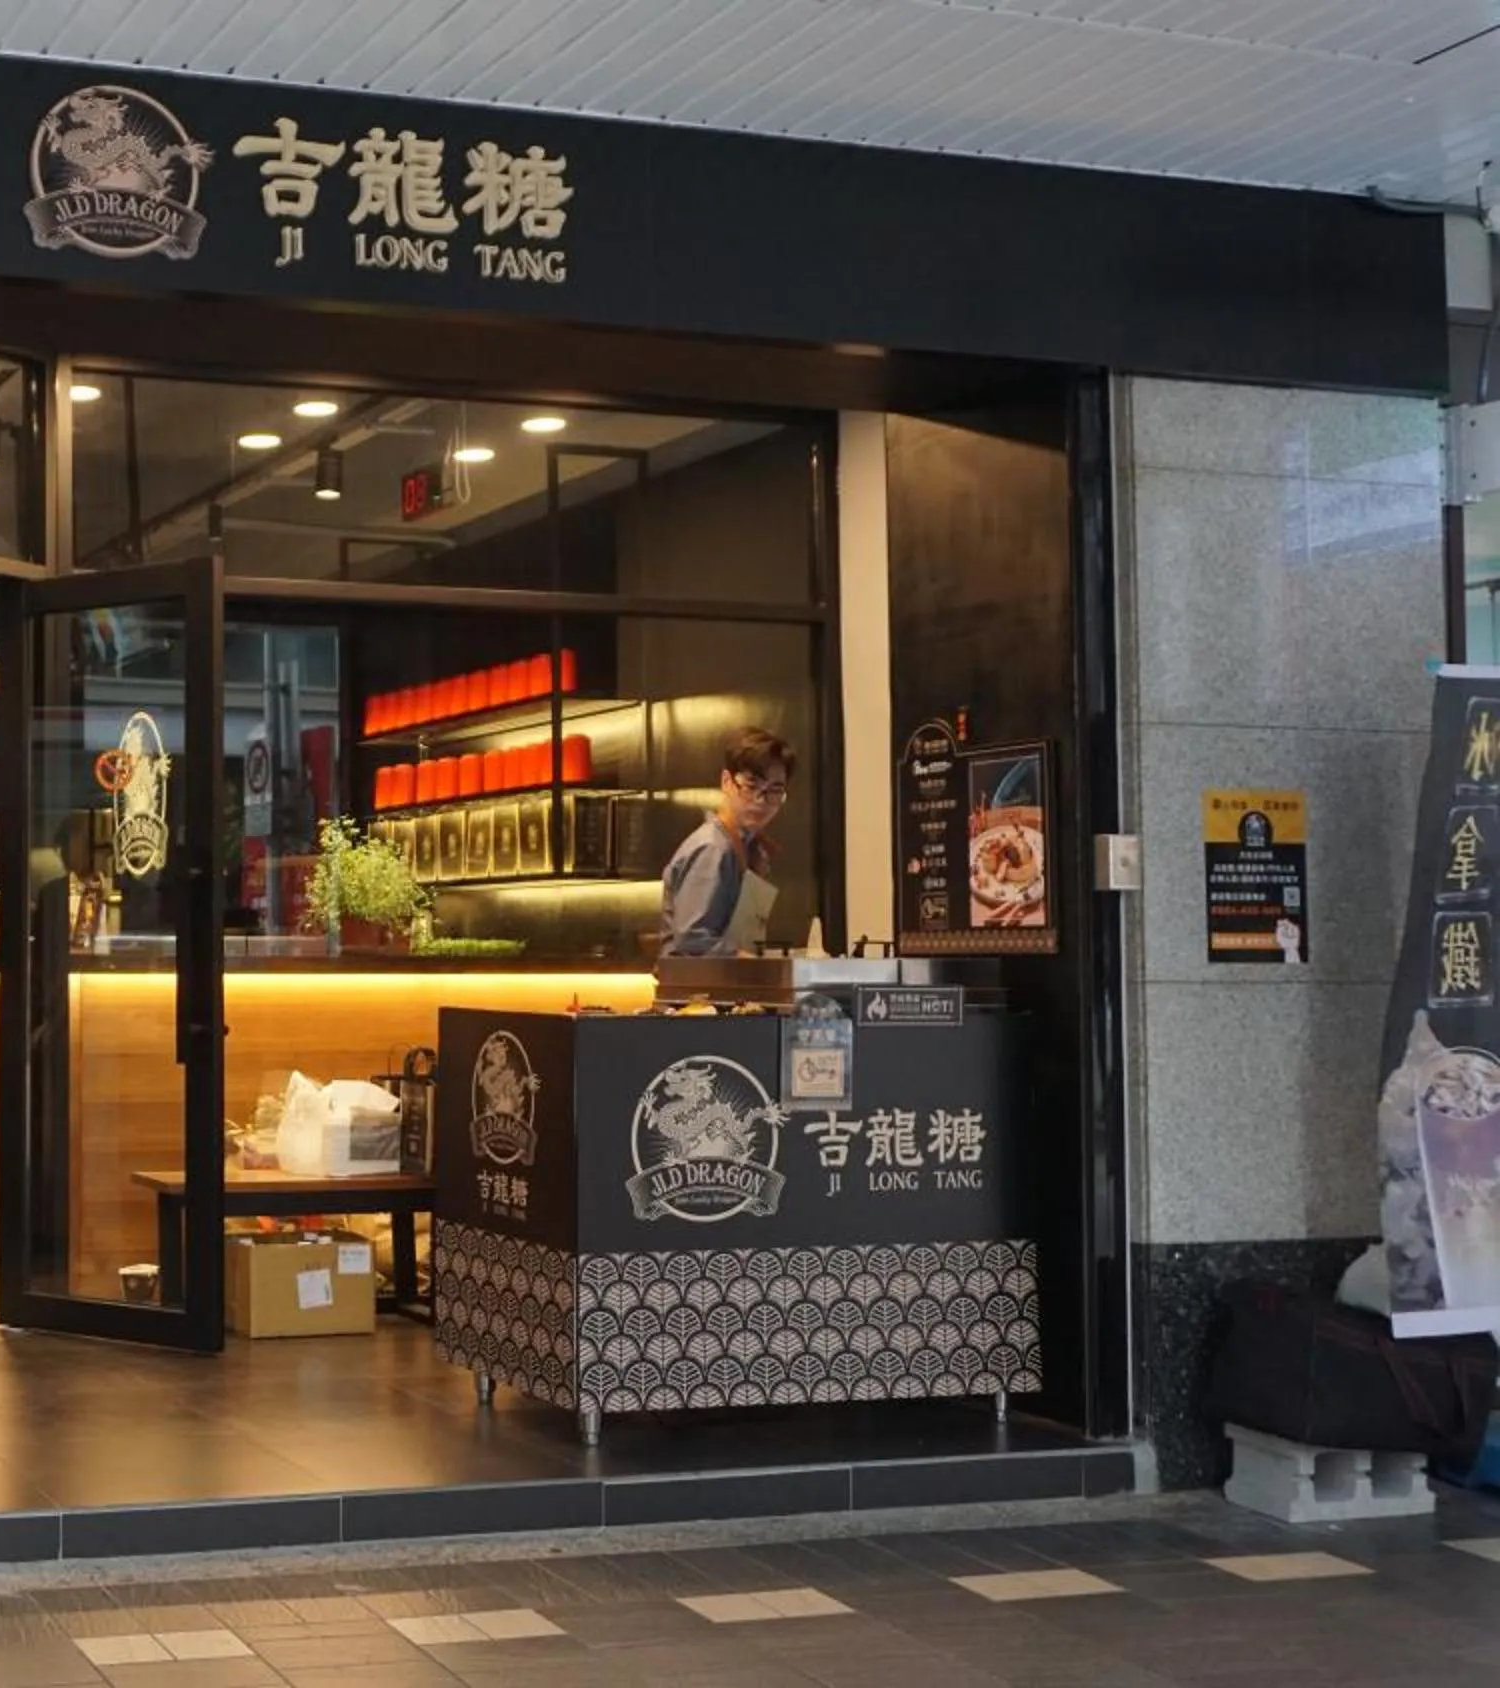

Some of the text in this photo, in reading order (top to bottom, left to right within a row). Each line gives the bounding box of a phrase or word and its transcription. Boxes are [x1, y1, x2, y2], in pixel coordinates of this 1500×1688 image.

[232, 116, 574, 240] 吉龍糖
[53, 191, 185, 234] JLD DRAGON
[275, 226, 567, 283] JI LONG TANG
[803, 1107, 986, 1167] 吉龍糖
[651, 1161, 767, 1197] JLD DRAGON
[827, 1169, 983, 1197] JI LONG TANG
